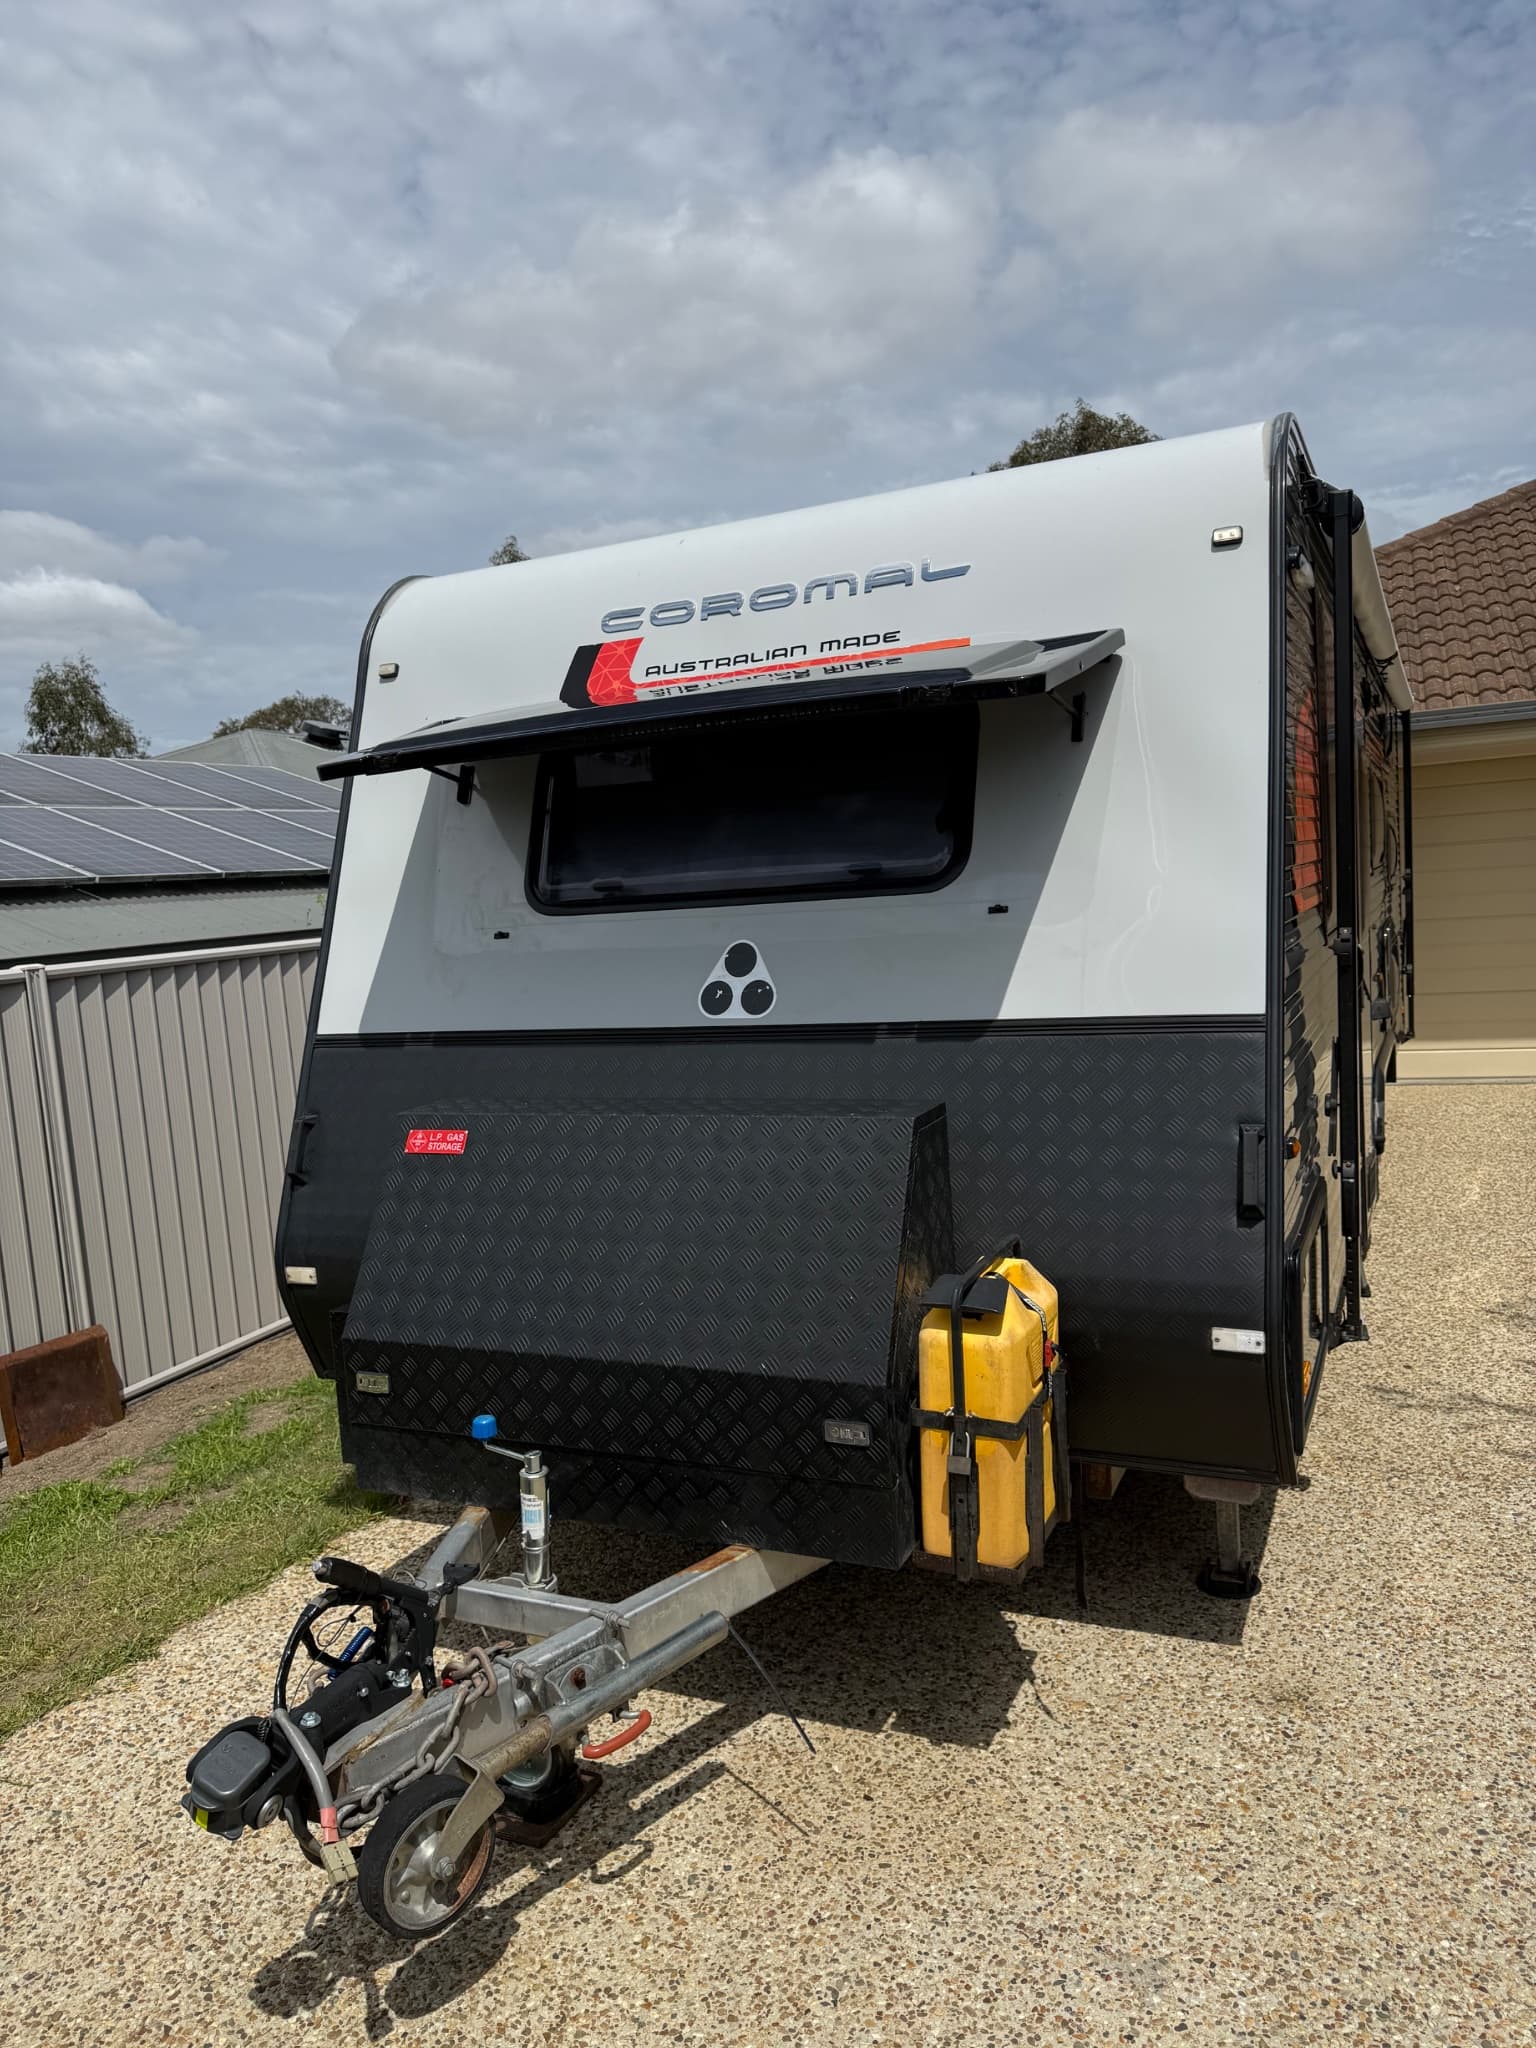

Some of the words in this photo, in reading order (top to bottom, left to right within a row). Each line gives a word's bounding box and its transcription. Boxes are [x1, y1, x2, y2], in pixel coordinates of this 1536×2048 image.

[601, 557, 971, 634] COROMAL
[645, 645, 807, 677] AUSTRALIAN
[820, 630, 901, 652] MADE
[427, 1142, 462, 1151] STORAGE
[446, 1133, 464, 1141] GAS
